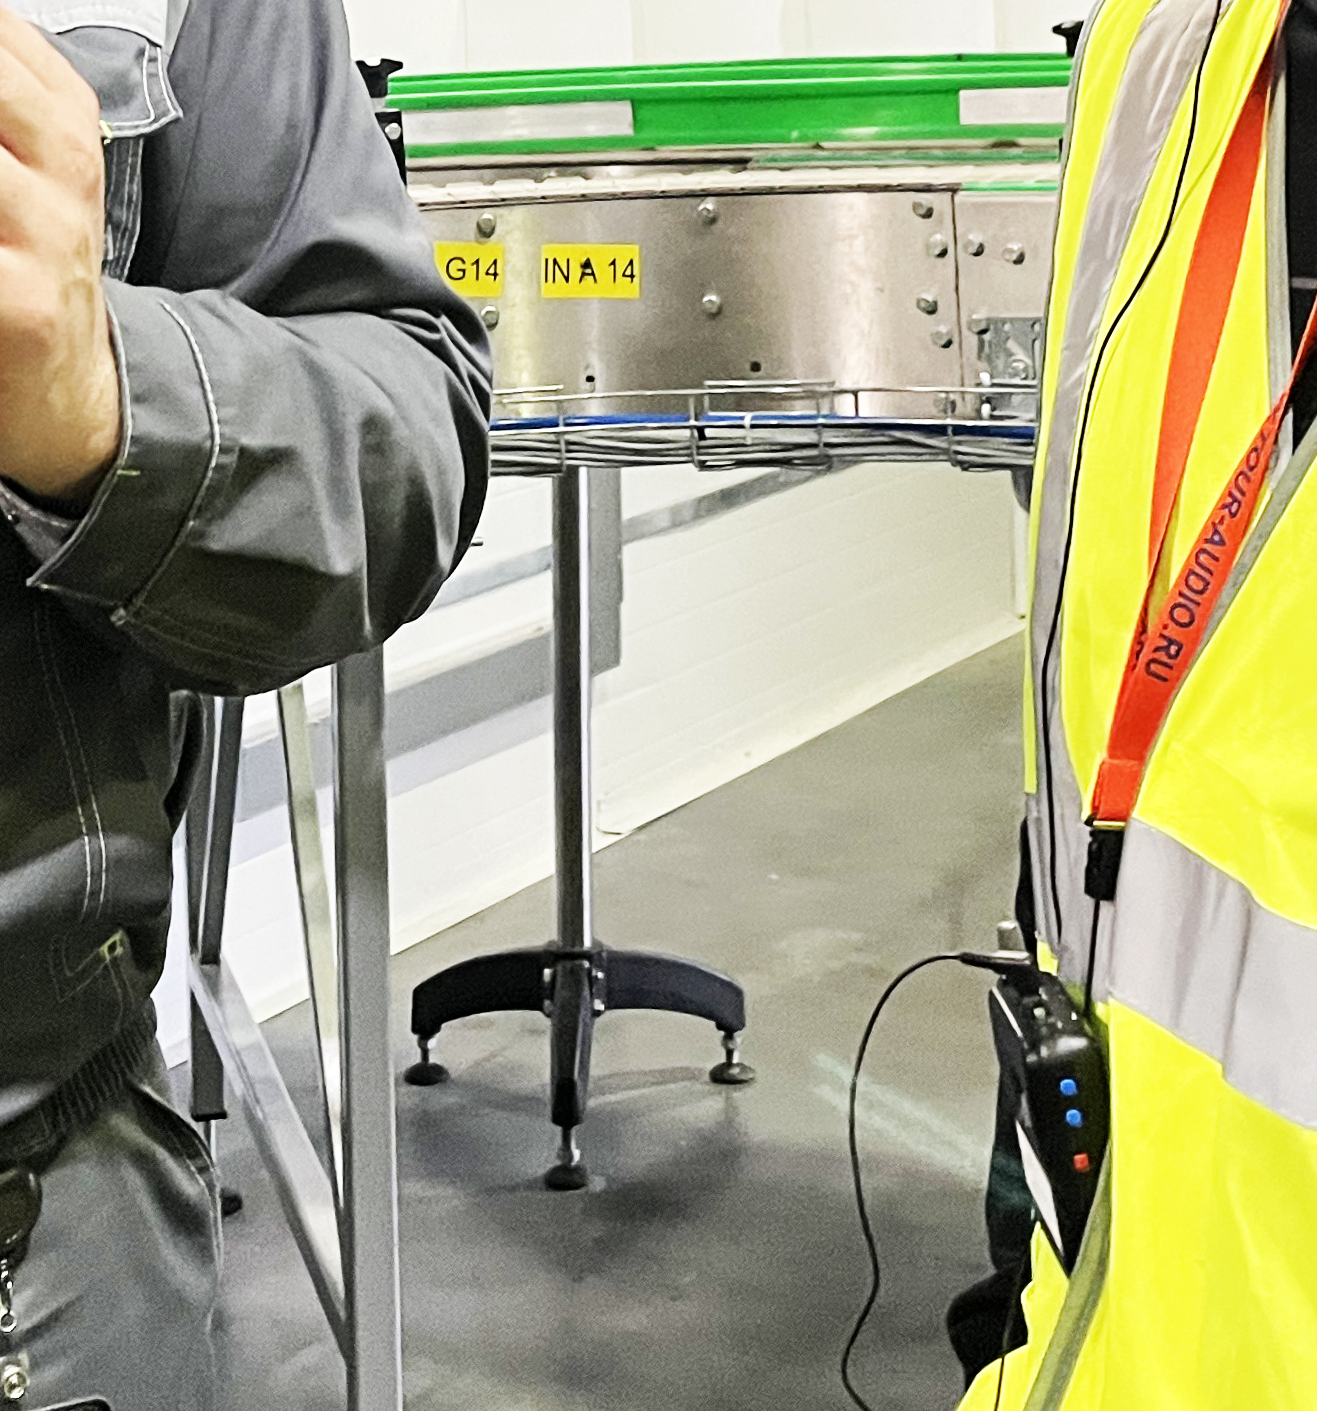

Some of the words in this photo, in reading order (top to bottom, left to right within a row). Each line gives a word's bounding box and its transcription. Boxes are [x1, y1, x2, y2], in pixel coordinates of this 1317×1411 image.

[445, 256, 500, 282] G14
[544, 258, 570, 284] IN
[578, 257, 598, 284] A
[607, 258, 636, 284] 14
